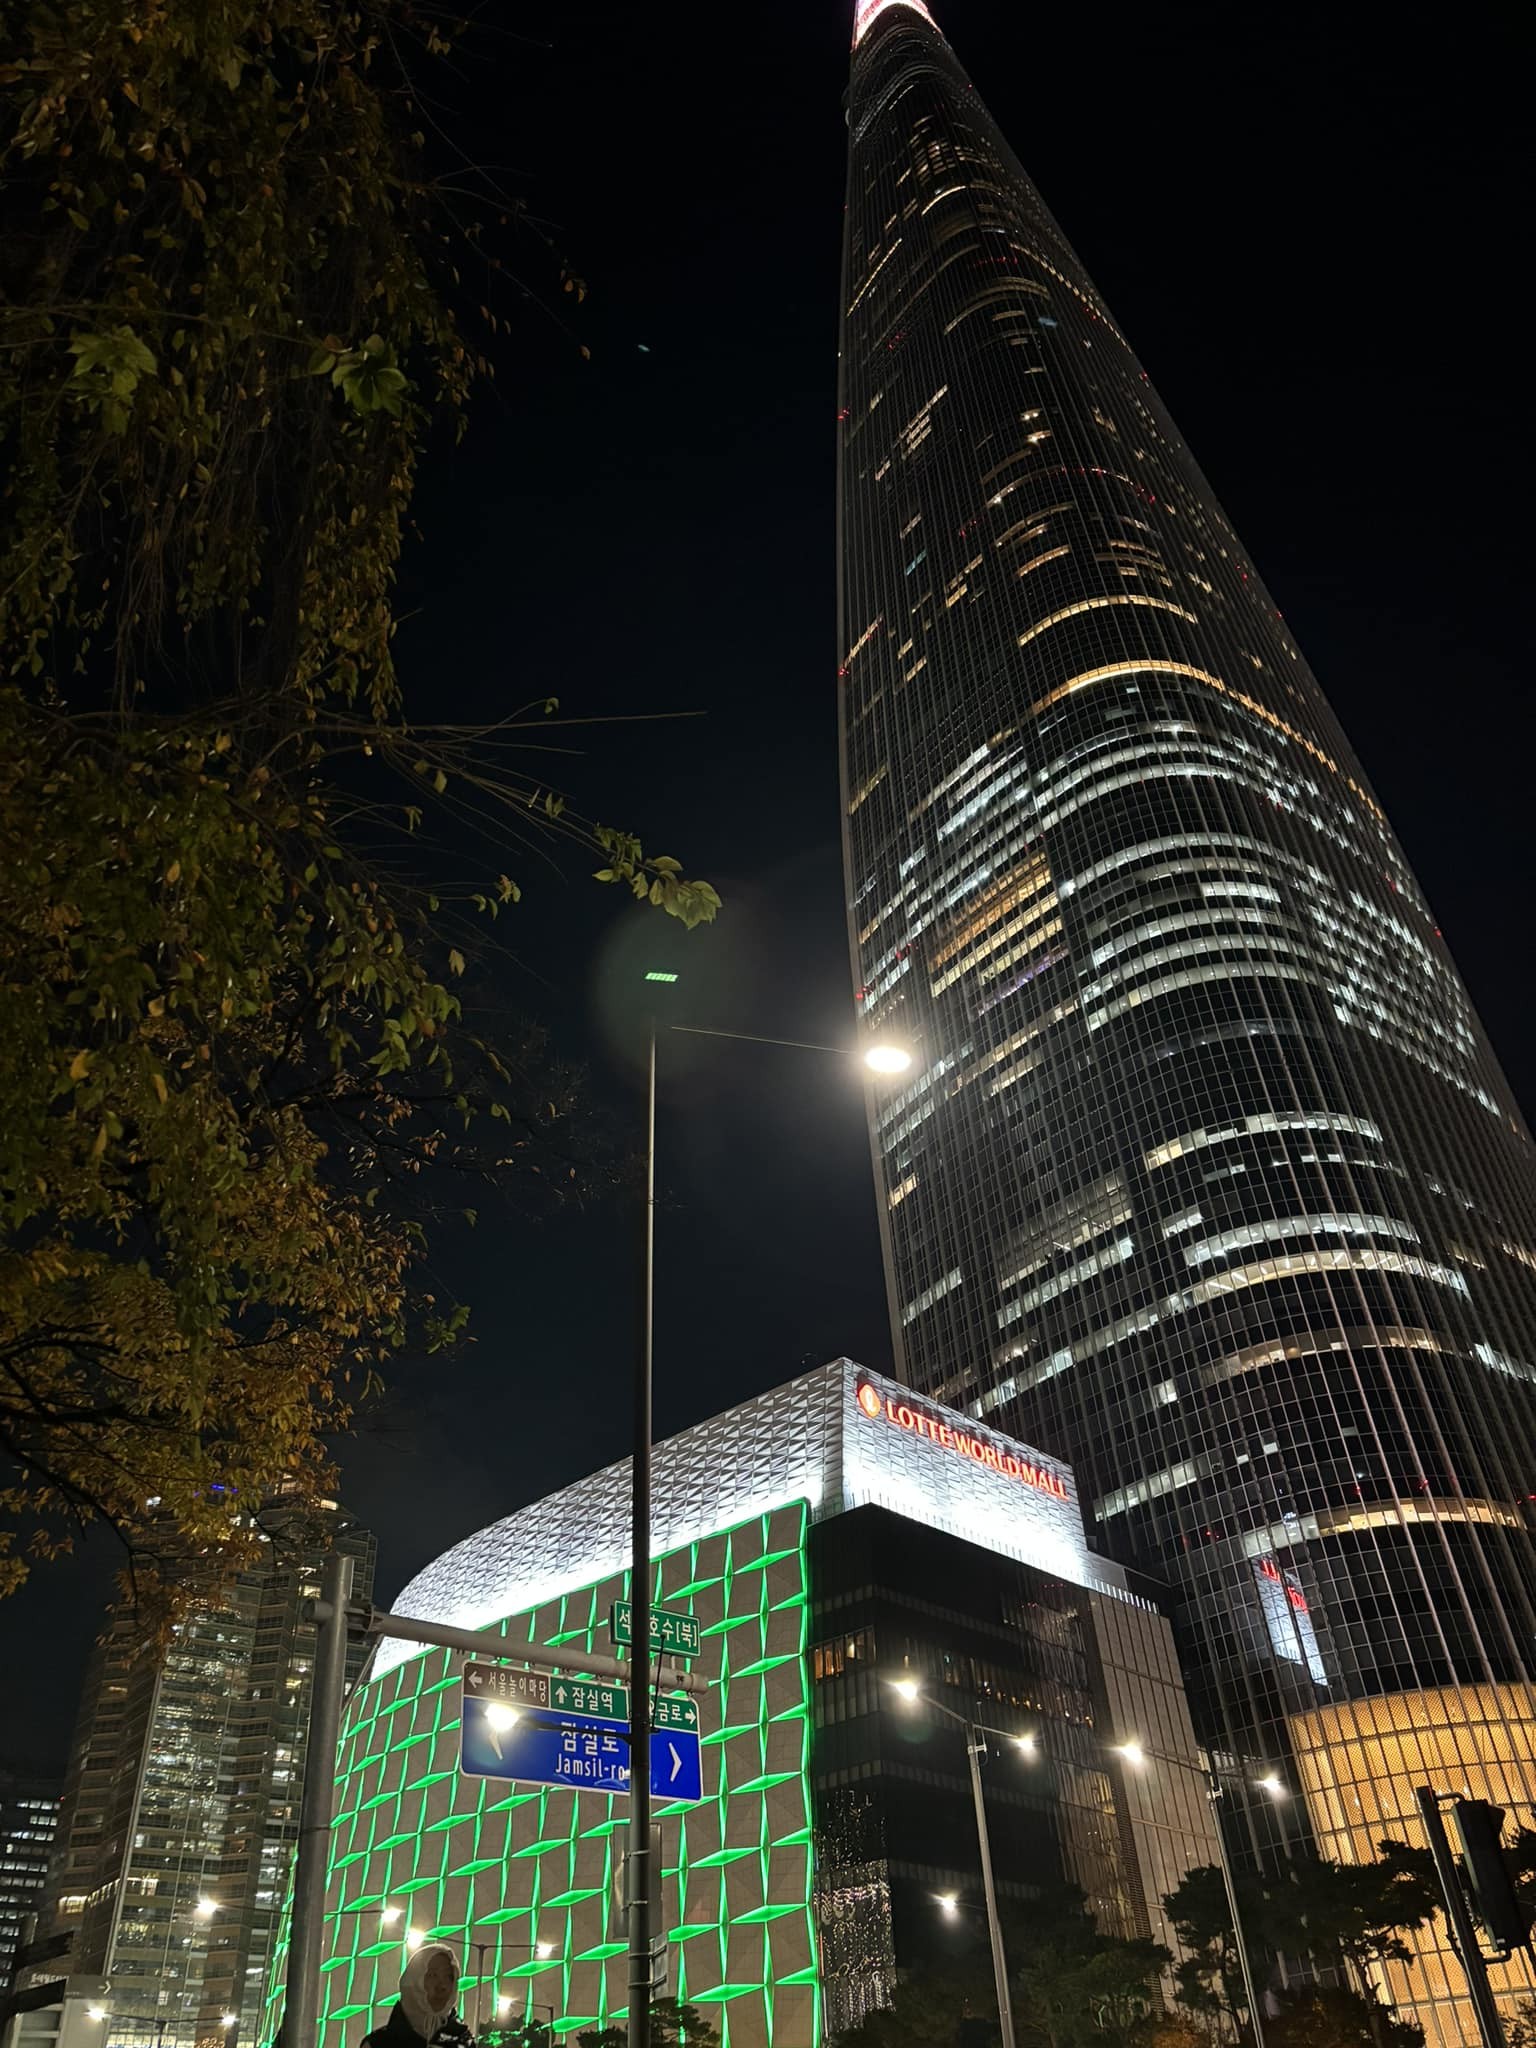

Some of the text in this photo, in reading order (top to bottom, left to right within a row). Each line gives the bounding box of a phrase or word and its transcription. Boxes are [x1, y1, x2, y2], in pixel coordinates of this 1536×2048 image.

[886, 1398, 1070, 1501] LOTTE WORLD MALL
[619, 1609, 697, 1648] 석호수[북]
[488, 1671, 547, 1703] 서울놀이마당
[572, 1687, 613, 1713] 잠실역
[561, 1722, 619, 1756] 잠실로
[555, 1753, 625, 1781] Jamsil-ro
